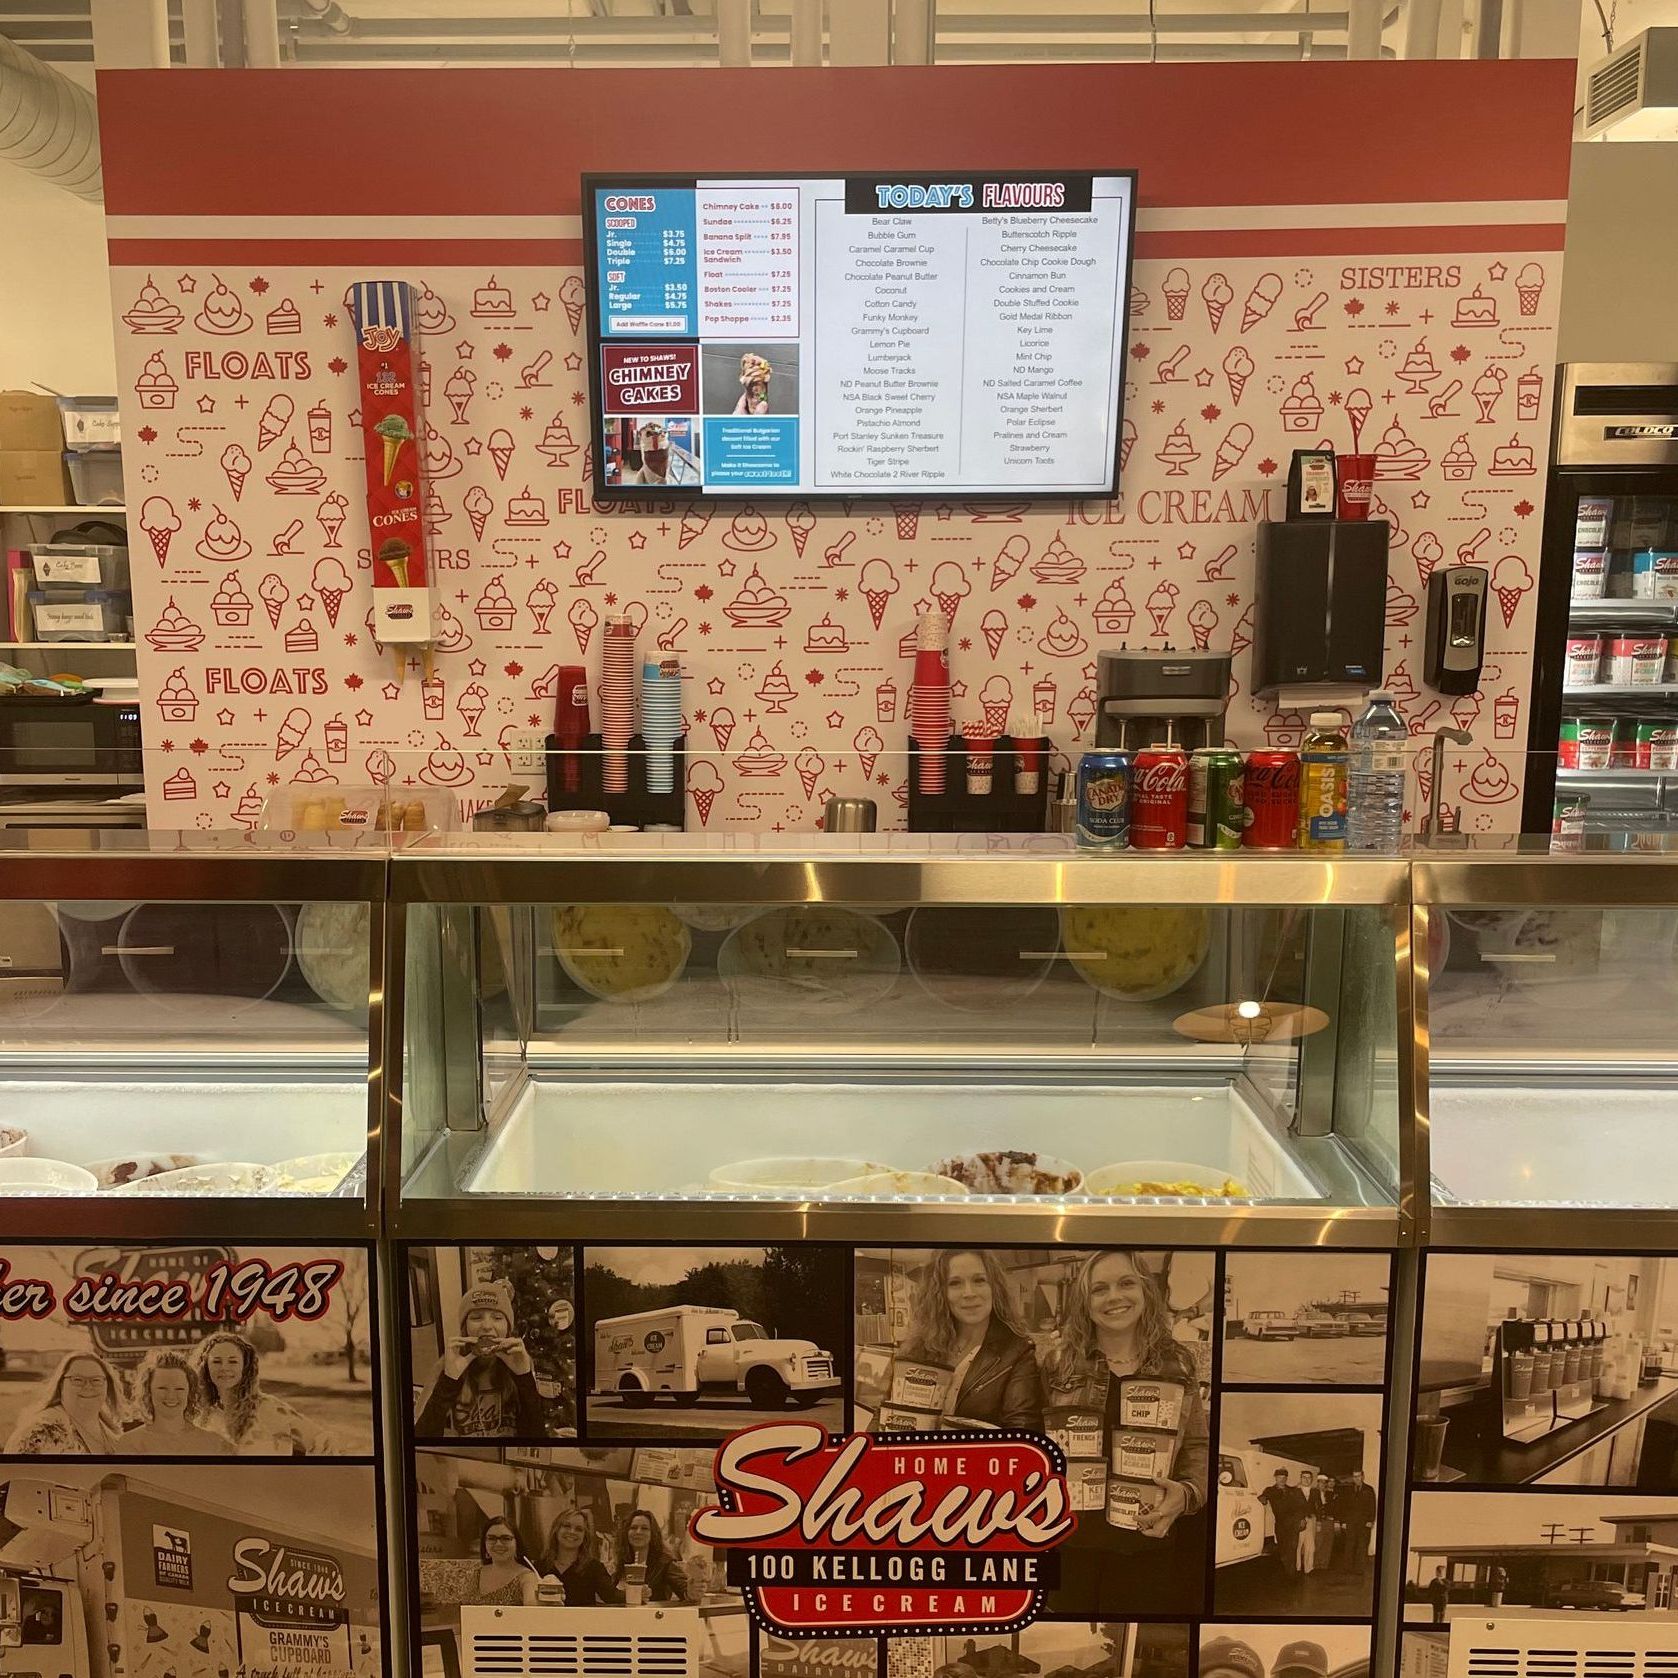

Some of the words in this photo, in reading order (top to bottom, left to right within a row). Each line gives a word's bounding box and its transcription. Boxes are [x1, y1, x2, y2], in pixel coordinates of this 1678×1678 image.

[876, 184, 974, 208] TODAY'S
[983, 183, 1065, 207] FLAVOURS
[605, 196, 655, 212] CONES
[703, 203, 737, 211] Chimney
[982, 217, 1008, 226] Betty's
[1010, 216, 1047, 225] Blueberry
[1050, 216, 1098, 224] Cheesecake
[735, 234, 751, 242] Split
[1053, 231, 1077, 239] Ripple
[884, 245, 916, 253] Caramel
[918, 245, 934, 254] Cup
[1001, 245, 1026, 253] Cherry
[607, 258, 630, 266] Triple
[856, 259, 894, 267] Chocolate
[896, 259, 927, 267] Brownie
[980, 258, 1019, 266] Chocolate
[1022, 258, 1039, 267] Chip
[1042, 258, 1068, 266] Cookie
[1071, 258, 1096, 267] Dough
[845, 273, 883, 281] Chocolate
[1340, 266, 1461, 289] SISTERS
[892, 300, 916, 309] Candy
[994, 299, 1020, 307] Double
[863, 314, 886, 322] Funky
[888, 314, 918, 322] Monkey
[1017, 326, 1032, 335] Key
[870, 340, 895, 348] Lemon
[898, 340, 910, 348] Pie
[868, 354, 911, 362] Lumberjack
[1035, 353, 1052, 362] Chip
[184, 351, 312, 380] FLOATS
[609, 363, 691, 385] CHIMNEY
[1028, 366, 1053, 375] Mango
[1024, 379, 1055, 387] Caramel
[1058, 379, 1082, 387] Coffee
[621, 385, 681, 404] CAKES
[910, 393, 935, 402] Cherry
[1016, 393, 1039, 401] Maple
[1042, 392, 1067, 400] Walnut
[855, 407, 883, 415] Orange
[886, 407, 922, 415] Pineapple
[1029, 419, 1055, 427] Eclipse
[851, 433, 878, 441] Stanley
[1010, 445, 1050, 453] Strawberry
[868, 458, 885, 466] Tiger
[888, 458, 909, 466] Stripe
[1065, 491, 1125, 525] ICE
[1137, 489, 1271, 524] CREAM
[372, 511, 418, 527] CONES
[205, 667, 328, 695] FLOATS
[1319, 768, 1335, 818] OASIS
[1098, 793, 1119, 806] DRY
[0, 1263, 49, 1312] er
[68, 1276, 186, 1314] since
[207, 1263, 337, 1315] 1948
[1132, 1410, 1150, 1418] CHIP
[894, 1456, 966, 1476] HOME
[988, 1457, 1020, 1476] OF
[695, 1425, 1072, 1545] Shaw's
[158, 1551, 188, 1565] DAIRY
[158, 1562, 189, 1575] FARMERS
[228, 1537, 346, 1601] Shaw's
[747, 1554, 795, 1580] 100
[813, 1555, 946, 1581] KELLOGG
[964, 1557, 1038, 1582] LANE
[793, 1593, 854, 1612] ICE
[873, 1594, 997, 1614] CREAM
[254, 1599, 280, 1612] ICE
[288, 1603, 335, 1620] CREAM
[269, 1631, 329, 1648] GRAMMY'S
[270, 1646, 331, 1664] CUPBOARD
[778, 1663, 834, 1676] DAIRY
